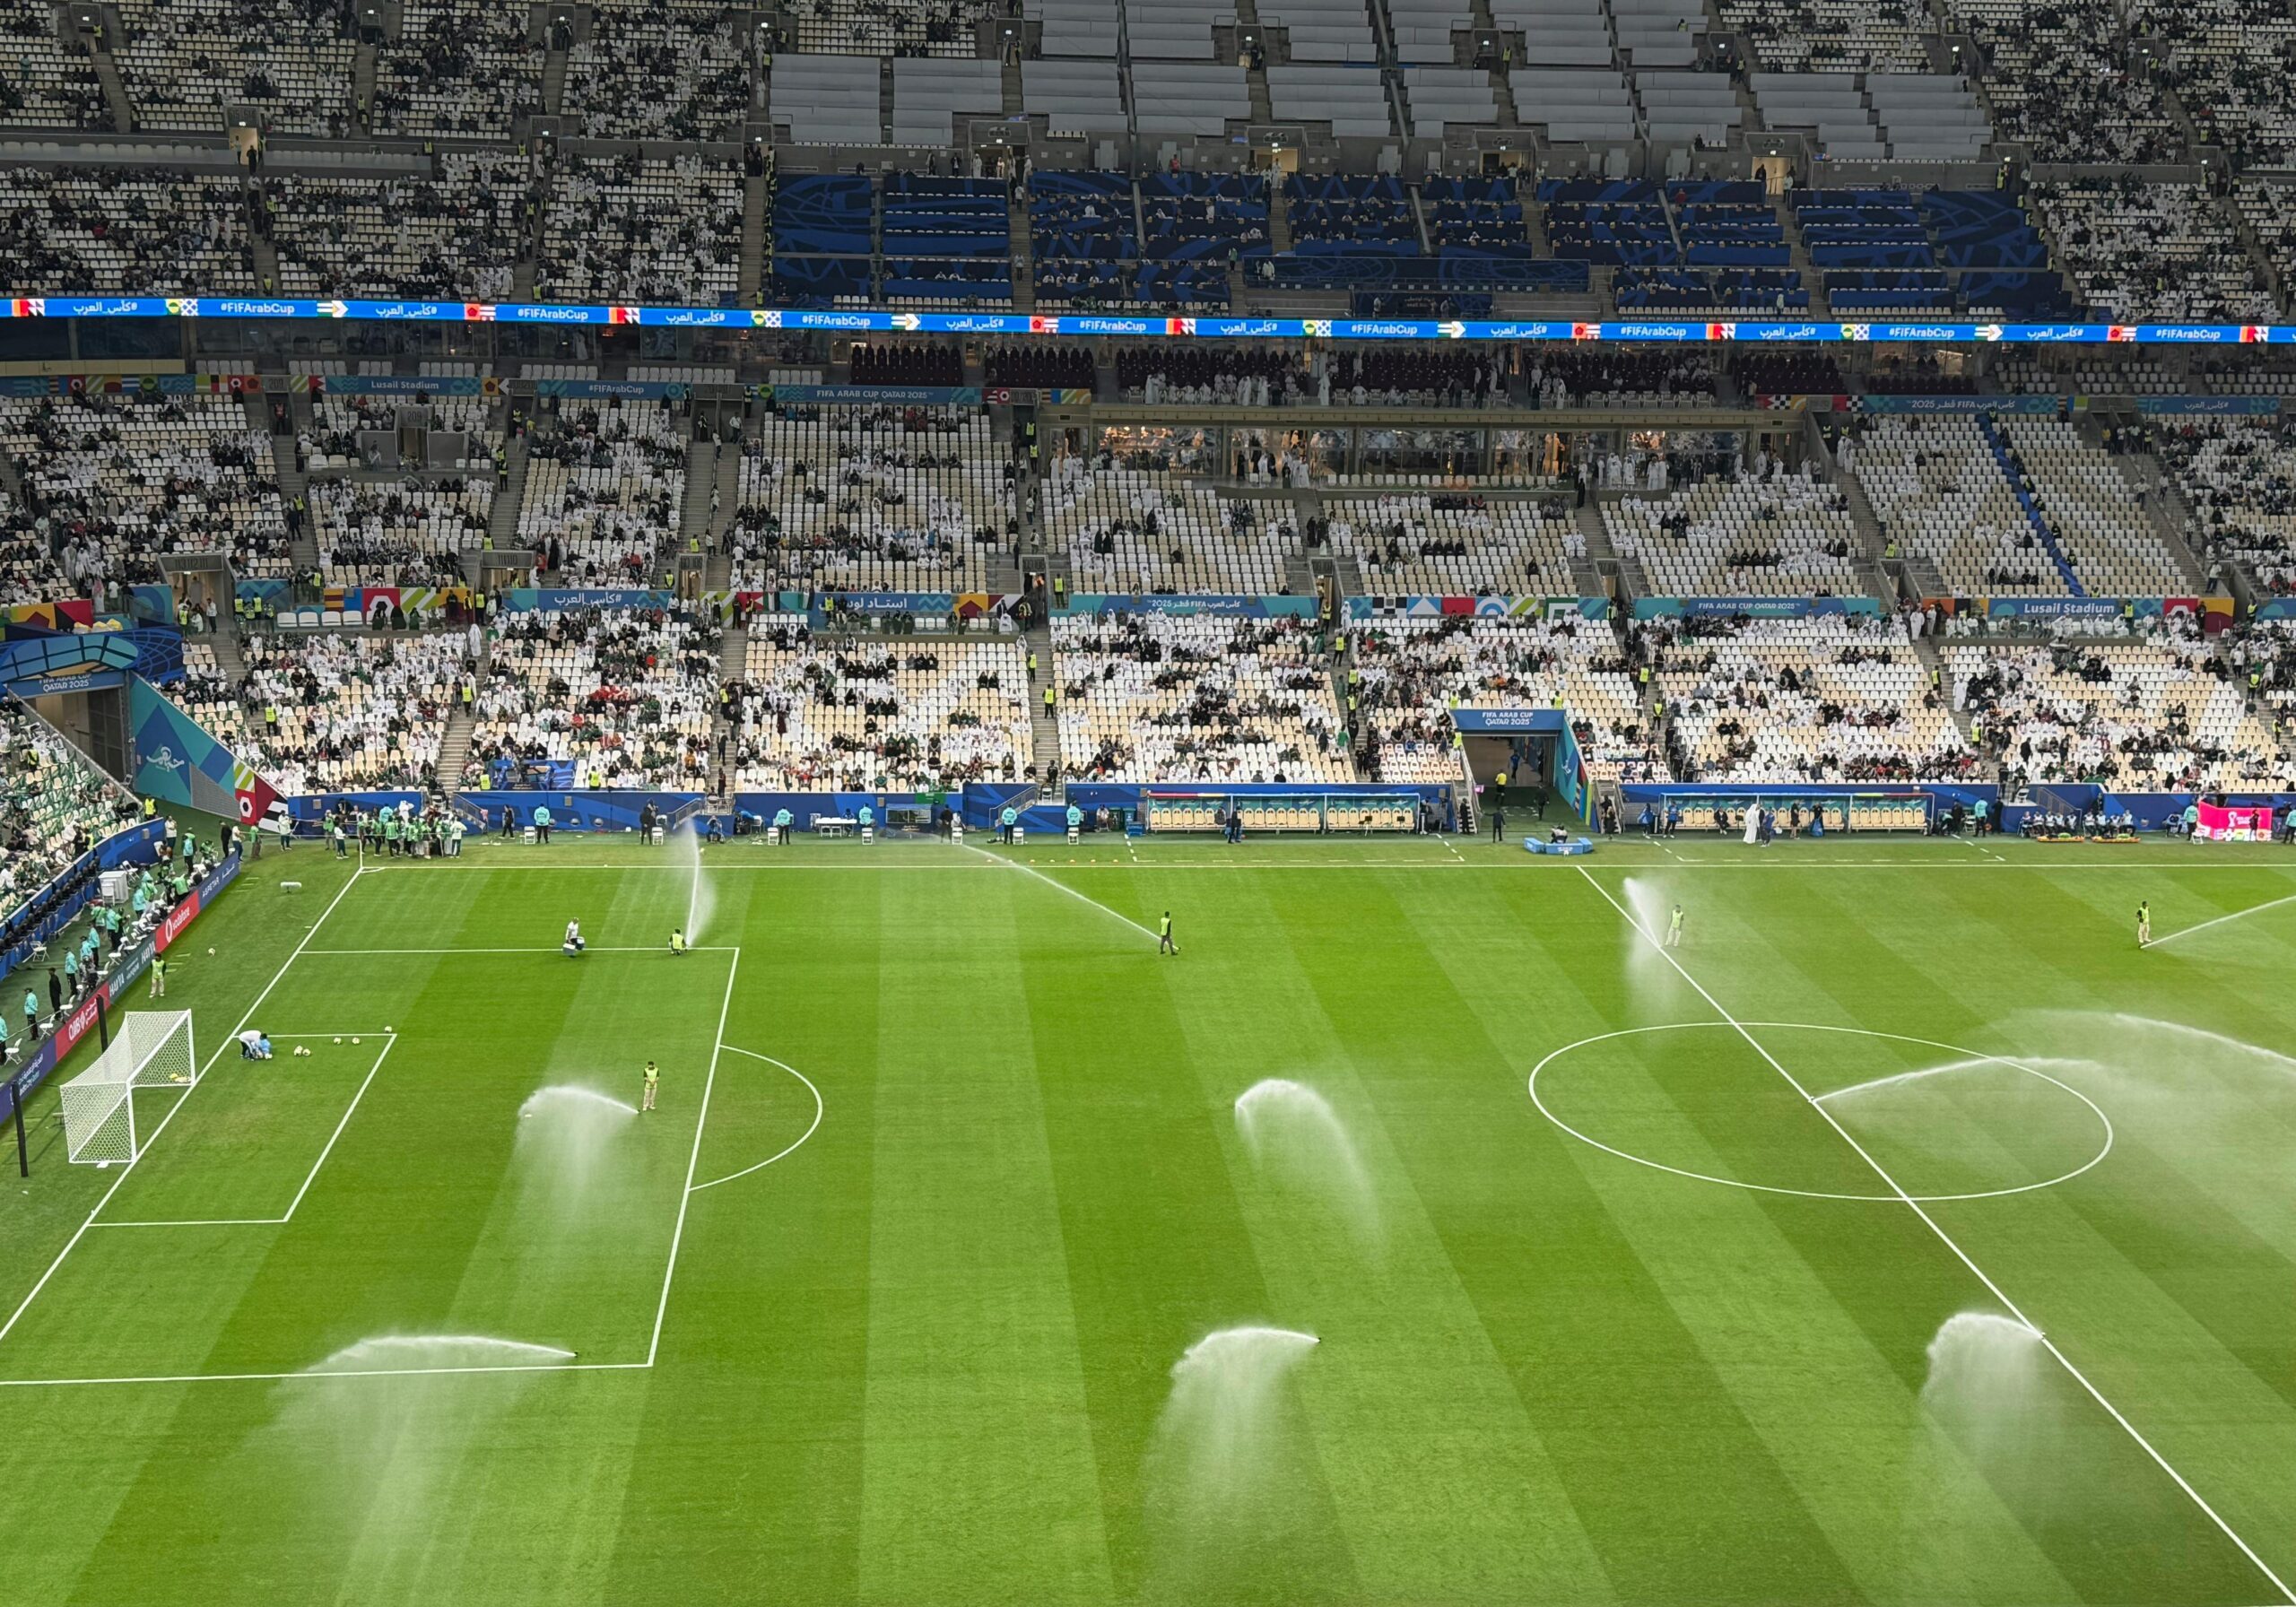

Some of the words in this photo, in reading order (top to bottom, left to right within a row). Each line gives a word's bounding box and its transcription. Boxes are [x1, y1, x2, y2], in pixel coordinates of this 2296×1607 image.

[74, 300, 138, 313] #كأس_العرب
[221, 302, 294, 317] #FIFArabCup
[377, 305, 438, 318] #كأس_العرب
[517, 308, 588, 323] #FIFArabCup
[665, 311, 726, 324] #كأس_العرب
[802, 314, 871, 327] #FIFArabCup
[946, 316, 1004, 329] #كأس_العرب
[1079, 318, 1146, 332] #FIFArabCup
[1221, 319, 1278, 333] #كأس_العرب
[1352, 322, 1418, 335] #FIFArabCup
[1491, 323, 1547, 336] #كأس_العرب
[1621, 325, 1686, 338] #FIFArabCup
[1760, 325, 1816, 338] #كأس_العرب
[1889, 326, 1955, 340] #FIFArabCup
[2027, 326, 2083, 340] #كأس_العرب
[2156, 327, 2221, 341] #FIFArabCup
[370, 380, 398, 389] Lusail
[401, 381, 439, 390] Stadium
[588, 385, 645, 395] #FIFArabCup
[816, 389, 835, 397] FIFA
[862, 390, 879, 398] CUP
[881, 390, 906, 399] QATAR
[1911, 400, 1935, 409] 2025
[1935, 399, 1956, 410] قطر
[1957, 401, 1976, 409] FIFA
[407, 411, 422, 422] 209
[867, 597, 908, 610] استاد
[1152, 599, 1172, 610] 2025
[1173, 599, 1189, 611] قطر
[1190, 601, 1206, 610] FIFA
[1738, 603, 1753, 611] CUP
[1754, 603, 1777, 611] QATAR
[2024, 603, 2060, 613] Lusail
[2063, 603, 2115, 613] Stadium
[43, 681, 68, 692] QATAR
[69, 679, 90, 689] 2025
[1485, 718, 1509, 726] QATAR
